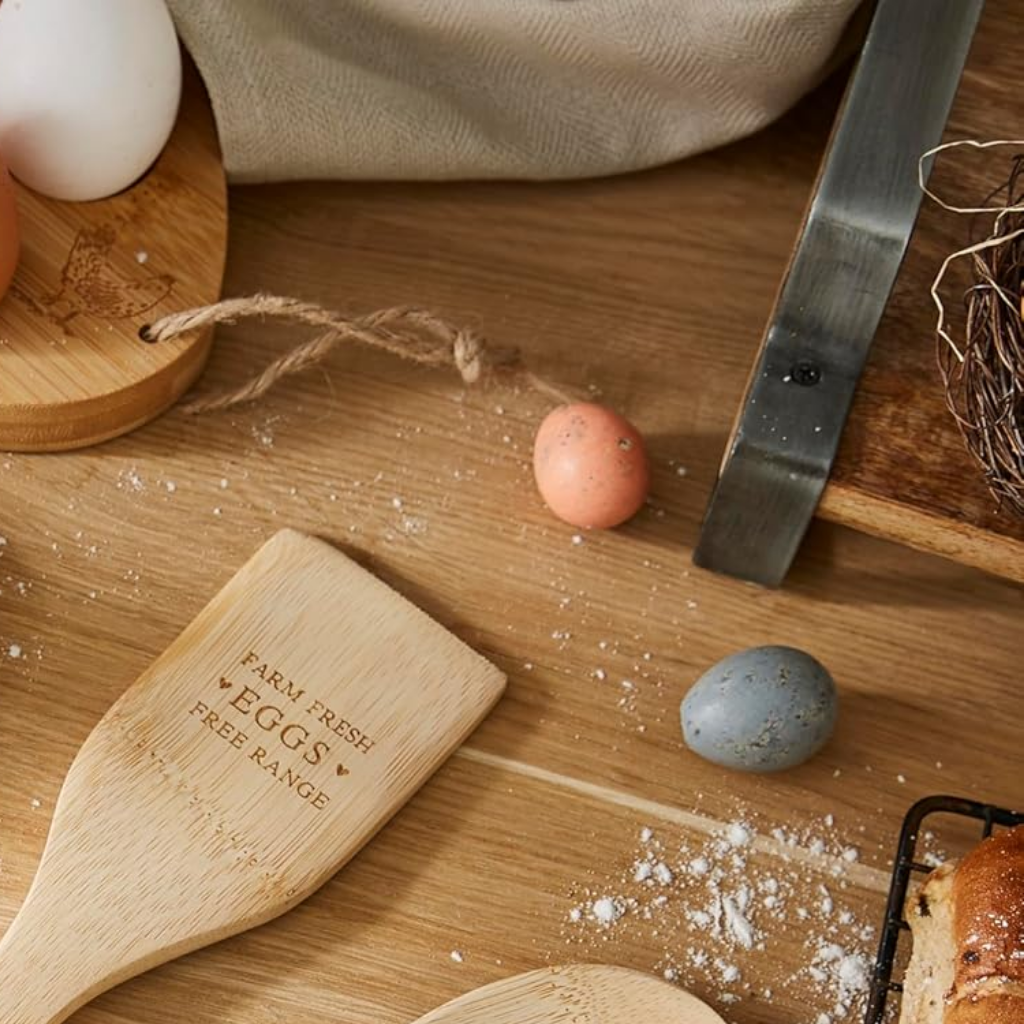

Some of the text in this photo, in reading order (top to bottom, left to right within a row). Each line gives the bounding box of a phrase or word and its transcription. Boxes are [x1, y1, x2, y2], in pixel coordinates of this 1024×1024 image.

[188, 700, 330, 810] FREE RANGE
[228, 685, 330, 766] EGGS
[240, 651, 376, 755] FARM FRESH
